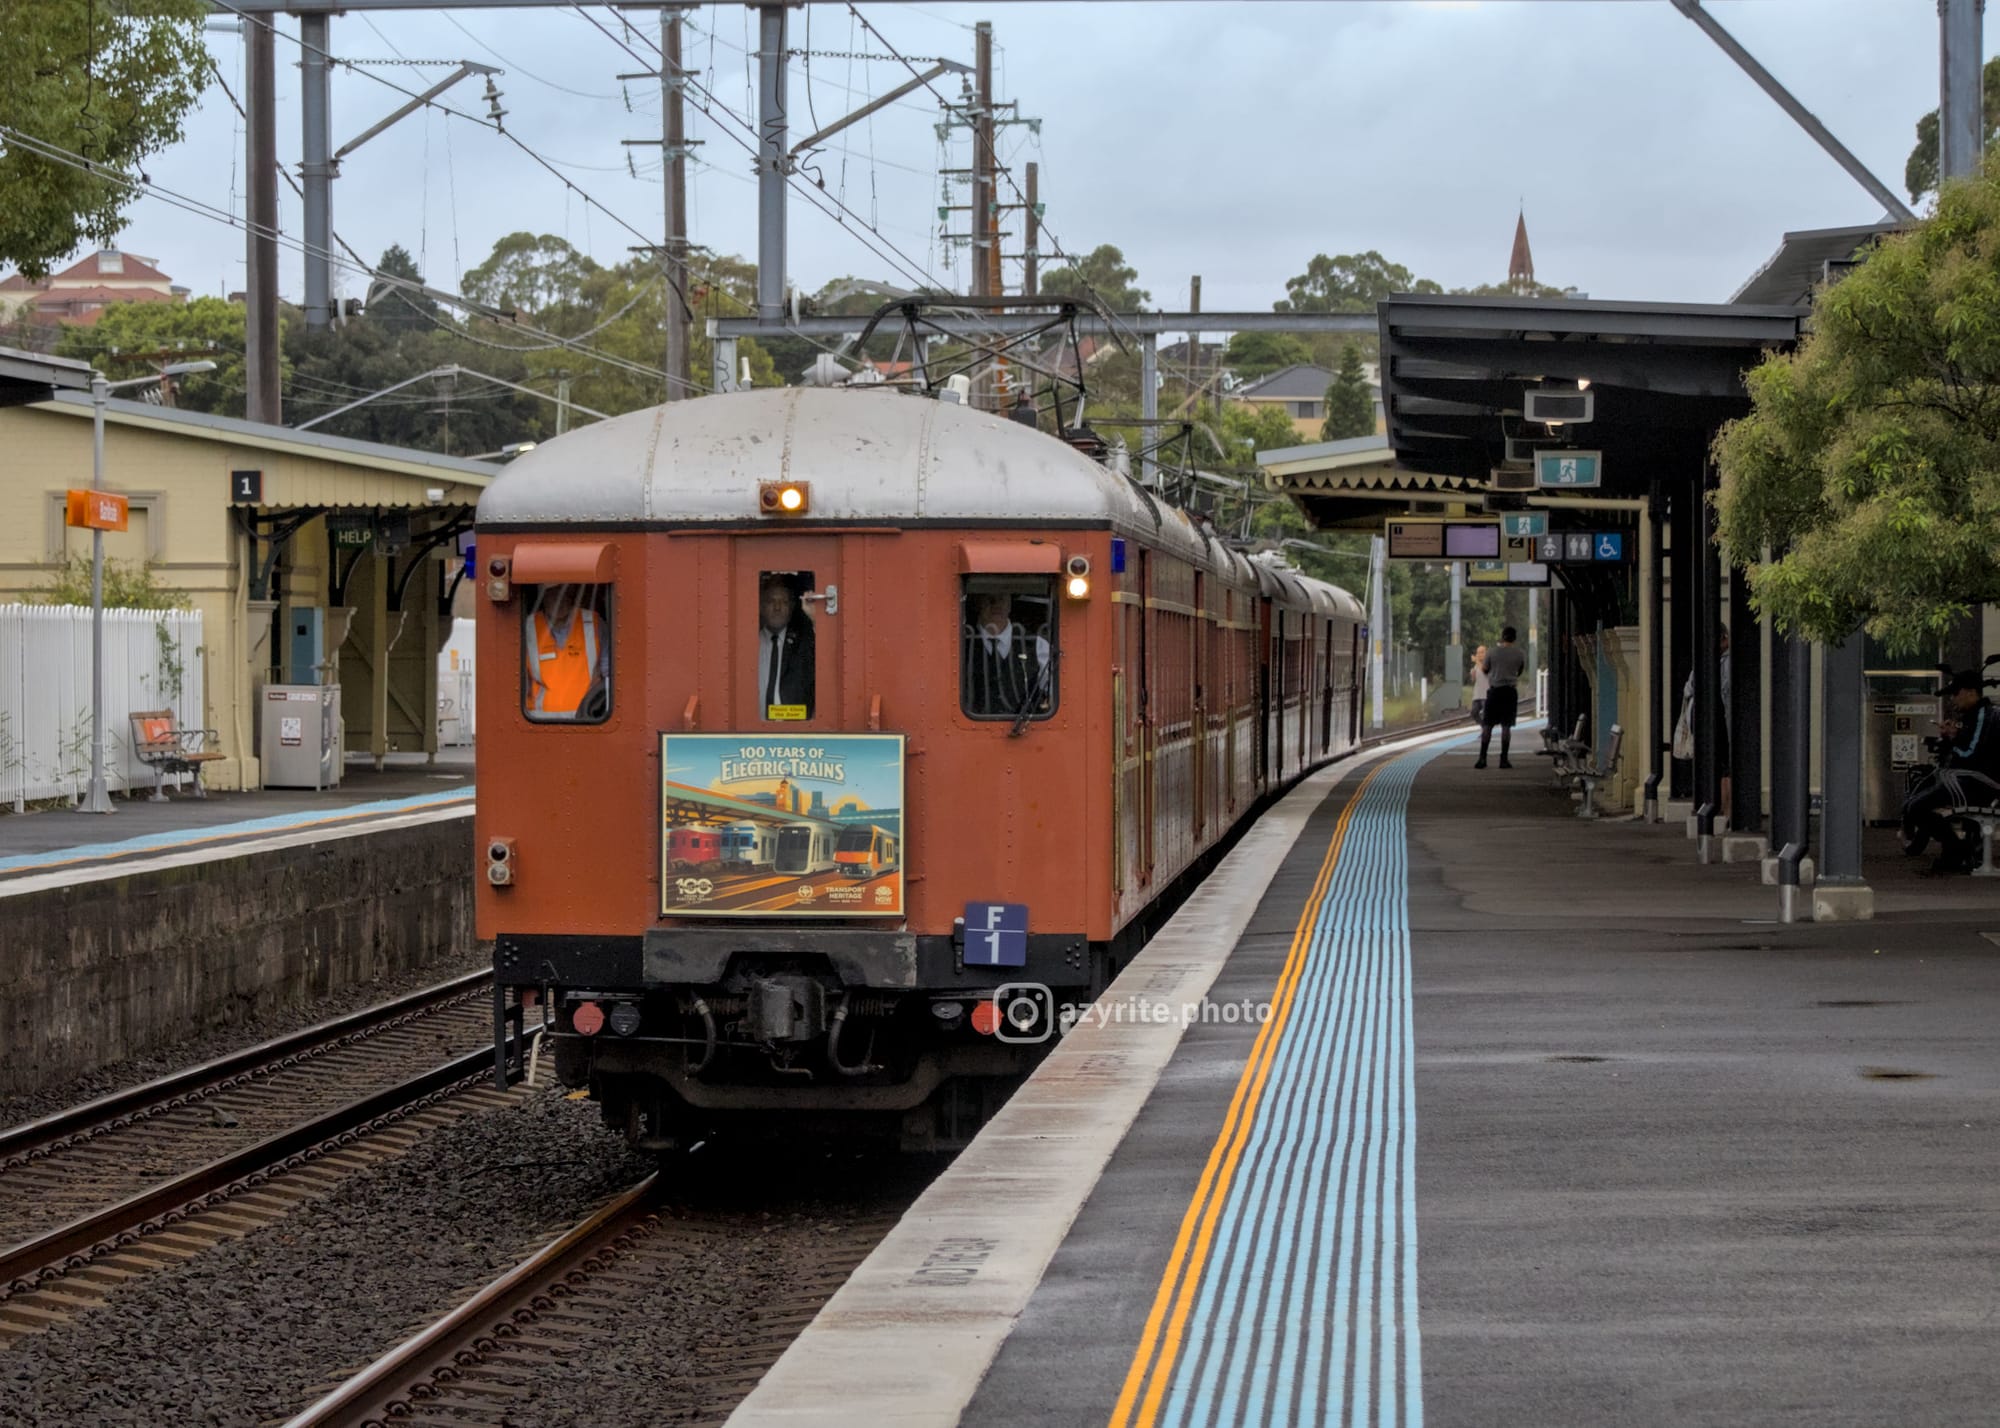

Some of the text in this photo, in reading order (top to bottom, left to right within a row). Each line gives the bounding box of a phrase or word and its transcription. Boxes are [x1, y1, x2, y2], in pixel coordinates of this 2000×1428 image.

[241, 477, 251, 494] 1
[339, 531, 371, 543] HELP
[740, 746, 825, 760] 100 YEARS OF
[722, 759, 844, 781] ELECTRIC TRAINS
[987, 906, 1004, 929] F
[984, 932, 999, 963] 1
